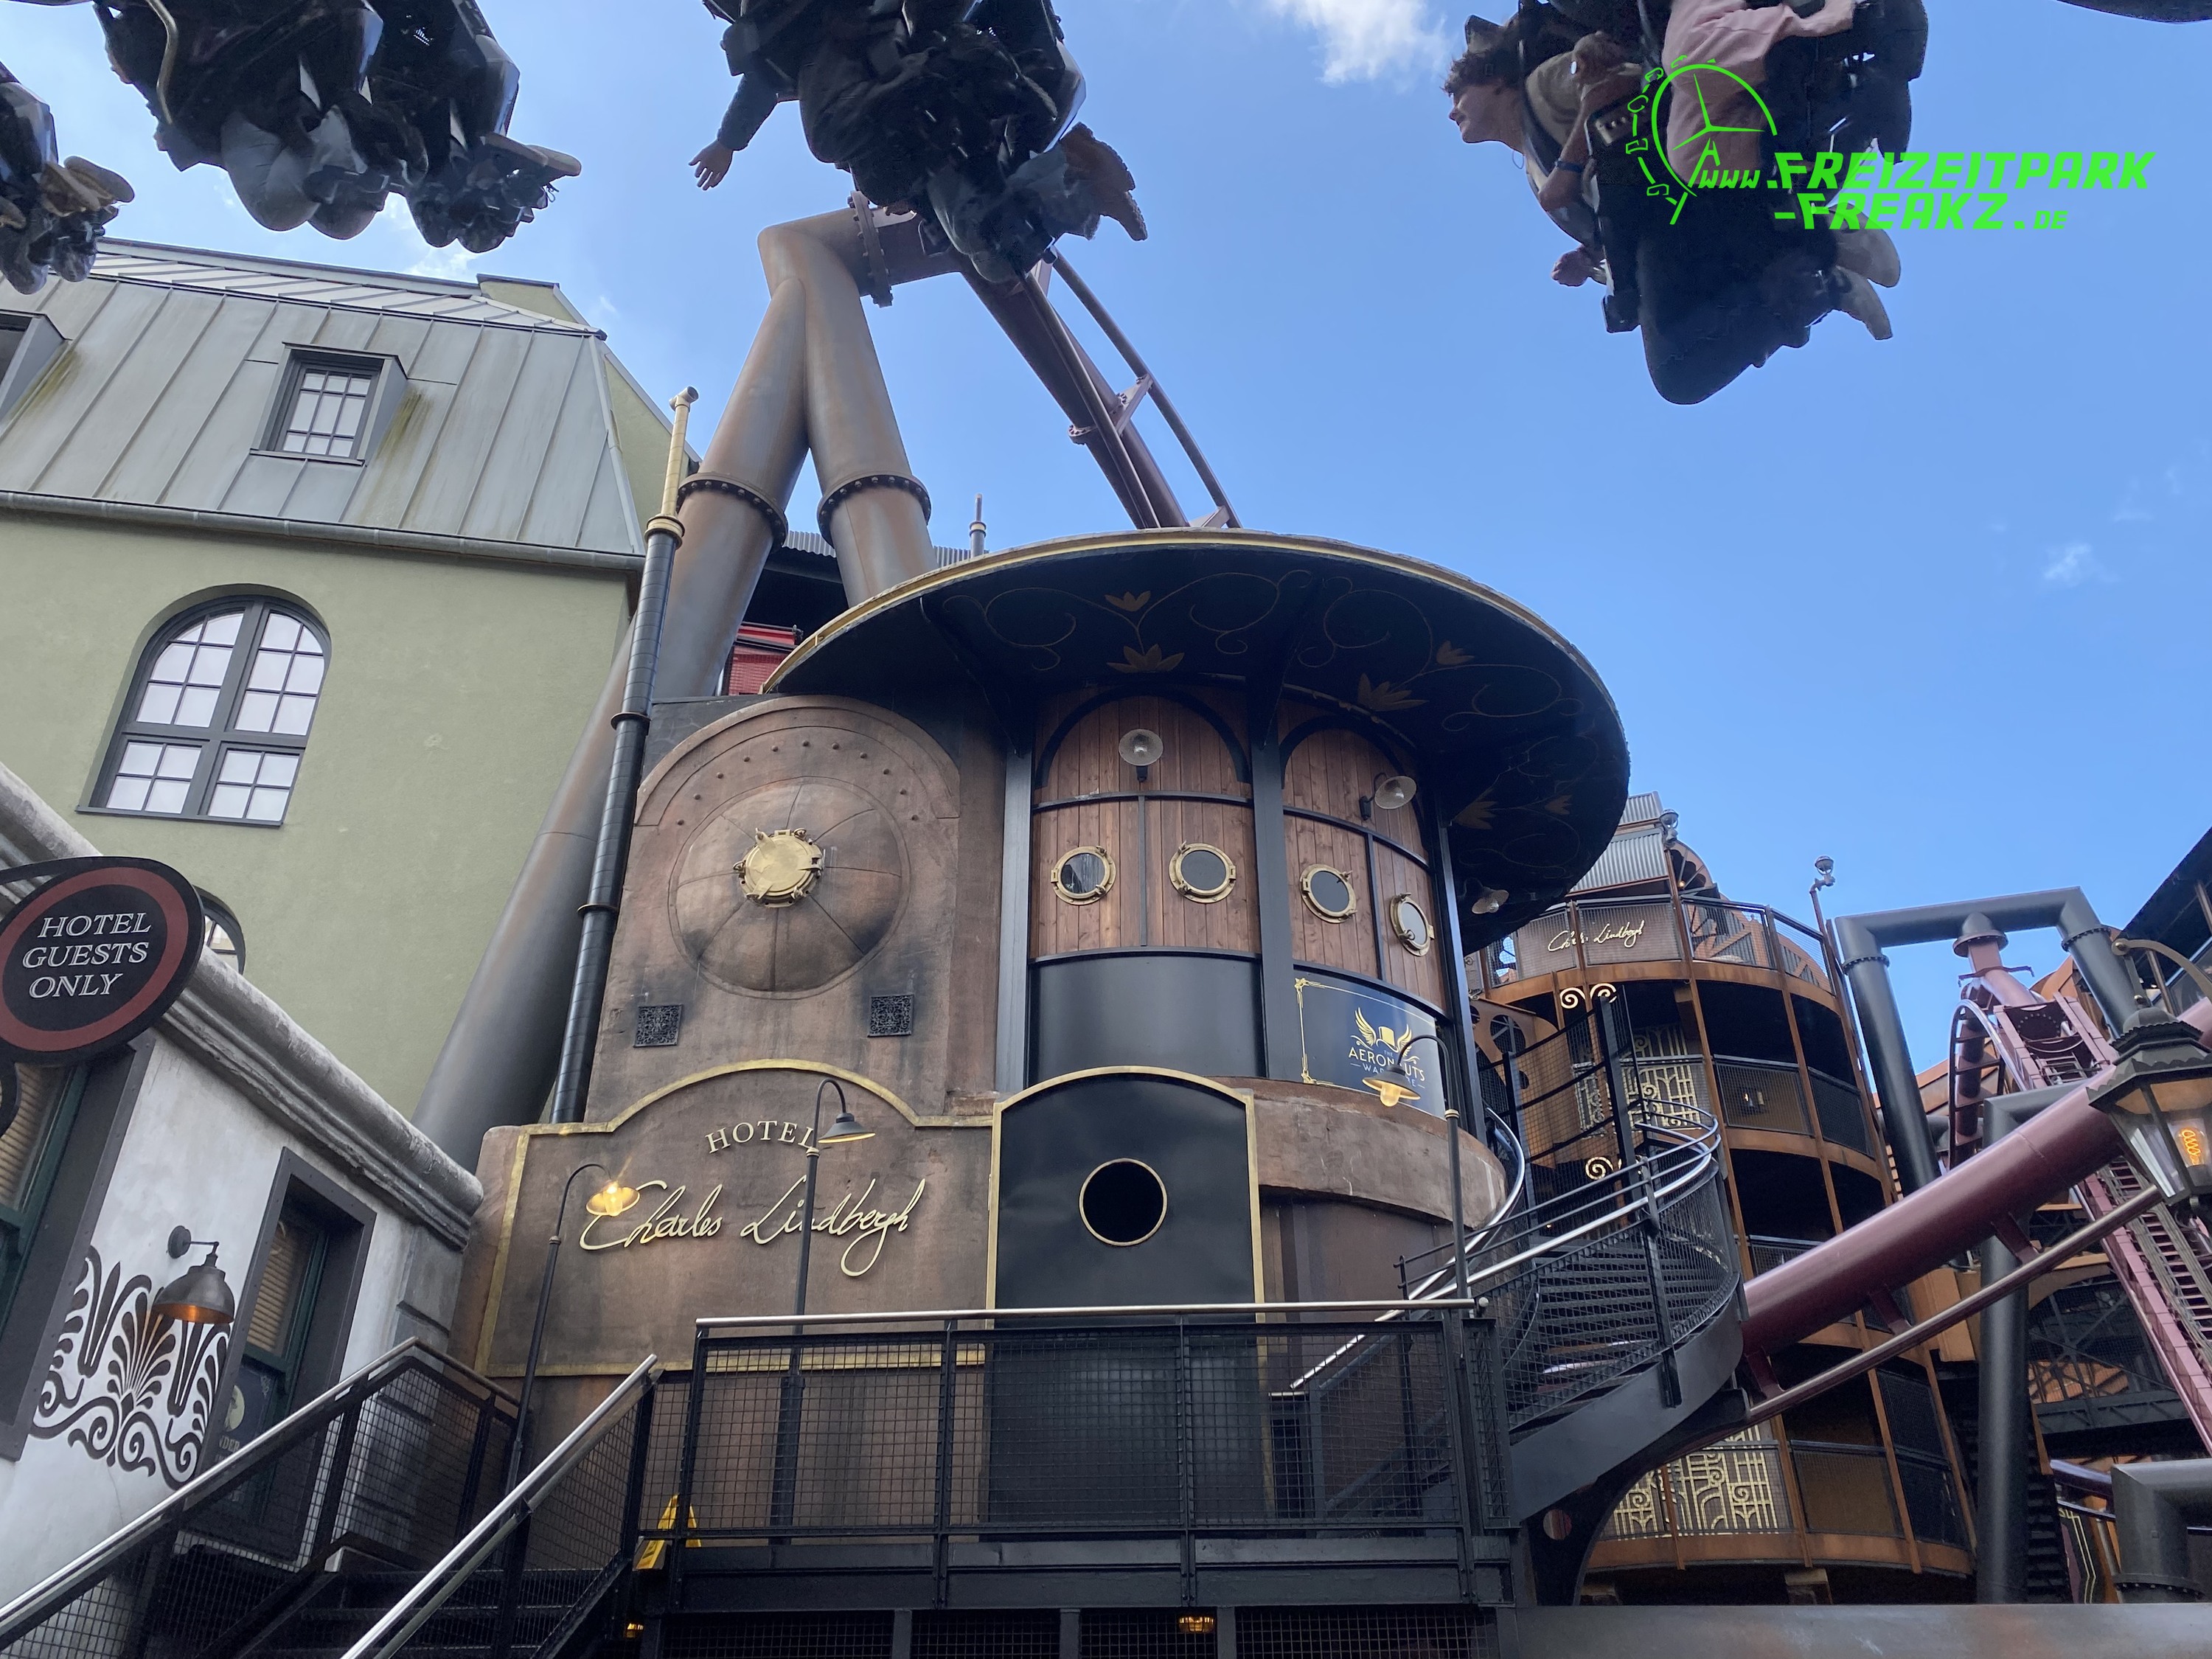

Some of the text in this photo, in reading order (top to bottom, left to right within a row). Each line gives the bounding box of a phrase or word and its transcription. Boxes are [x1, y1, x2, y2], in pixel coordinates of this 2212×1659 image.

[37, 912, 152, 939] HOTEL
[22, 941, 149, 969] GUESTS
[28, 973, 124, 999] ONLY
[704, 1120, 815, 1154] HOTEL
